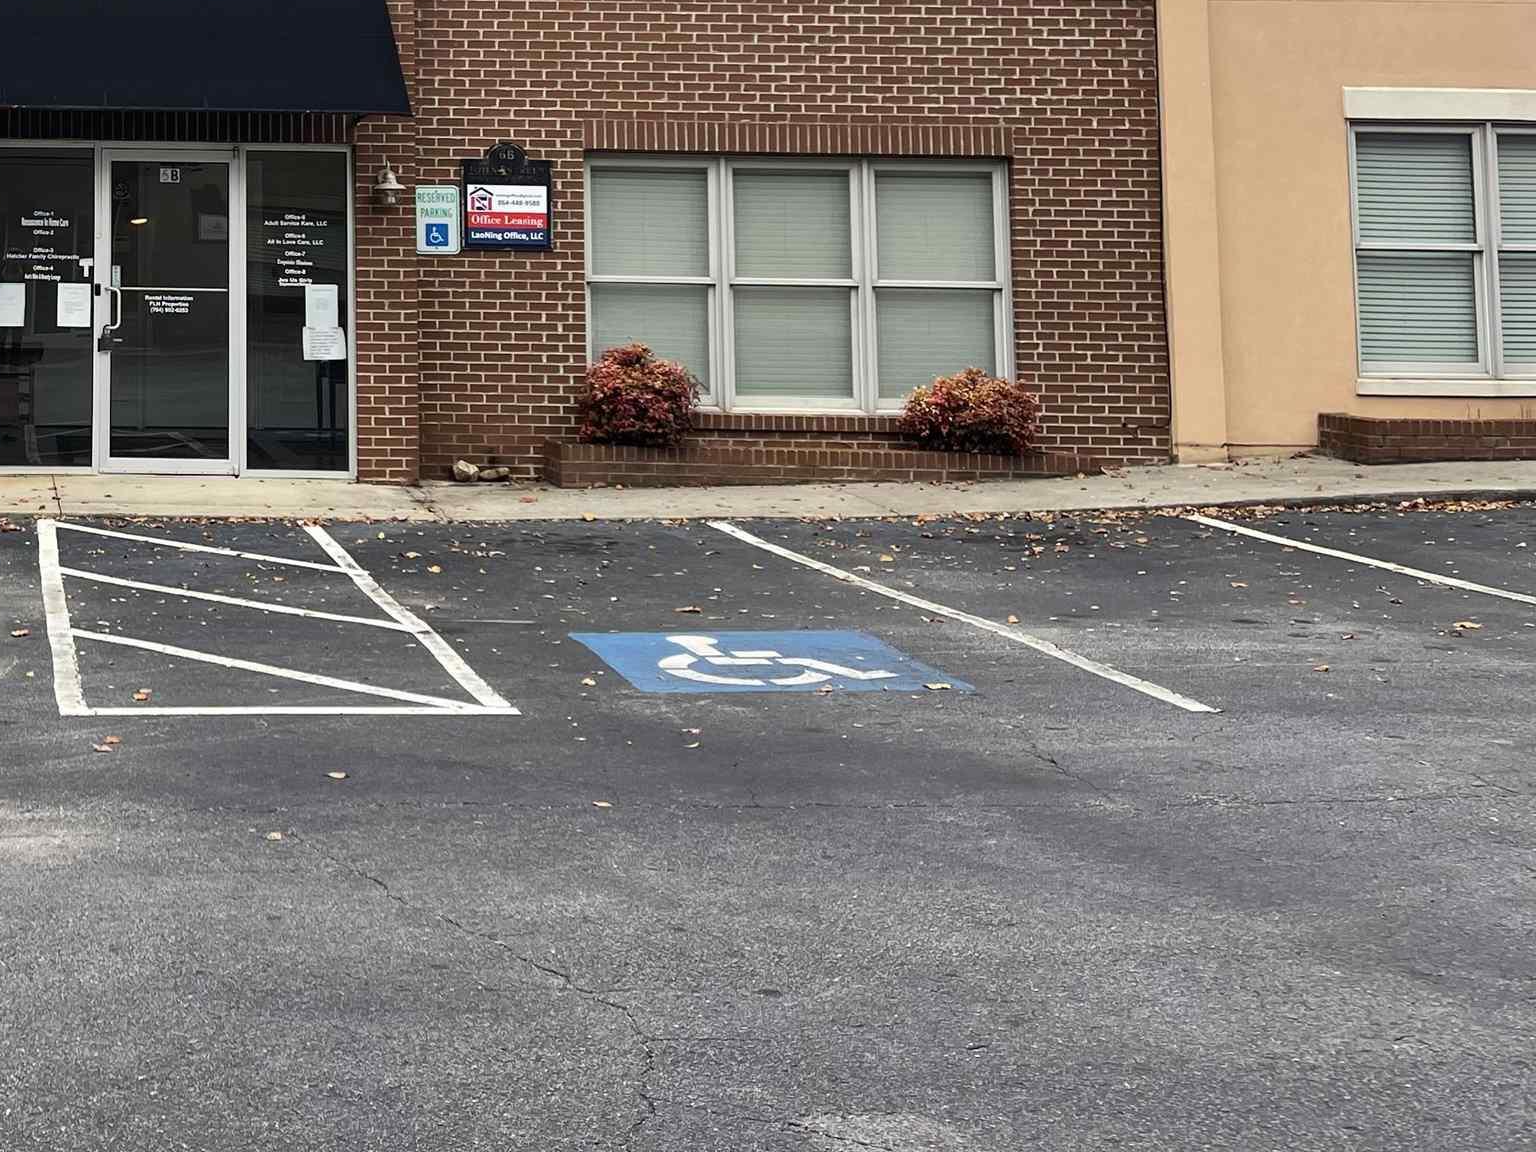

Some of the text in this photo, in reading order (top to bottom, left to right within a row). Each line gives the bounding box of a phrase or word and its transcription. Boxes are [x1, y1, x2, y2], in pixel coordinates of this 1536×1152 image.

[417, 192, 456, 204] RESERVED
[420, 207, 454, 218] PARKING
[471, 215, 545, 228] Office Leasing
[530, 232, 544, 240] LLC
